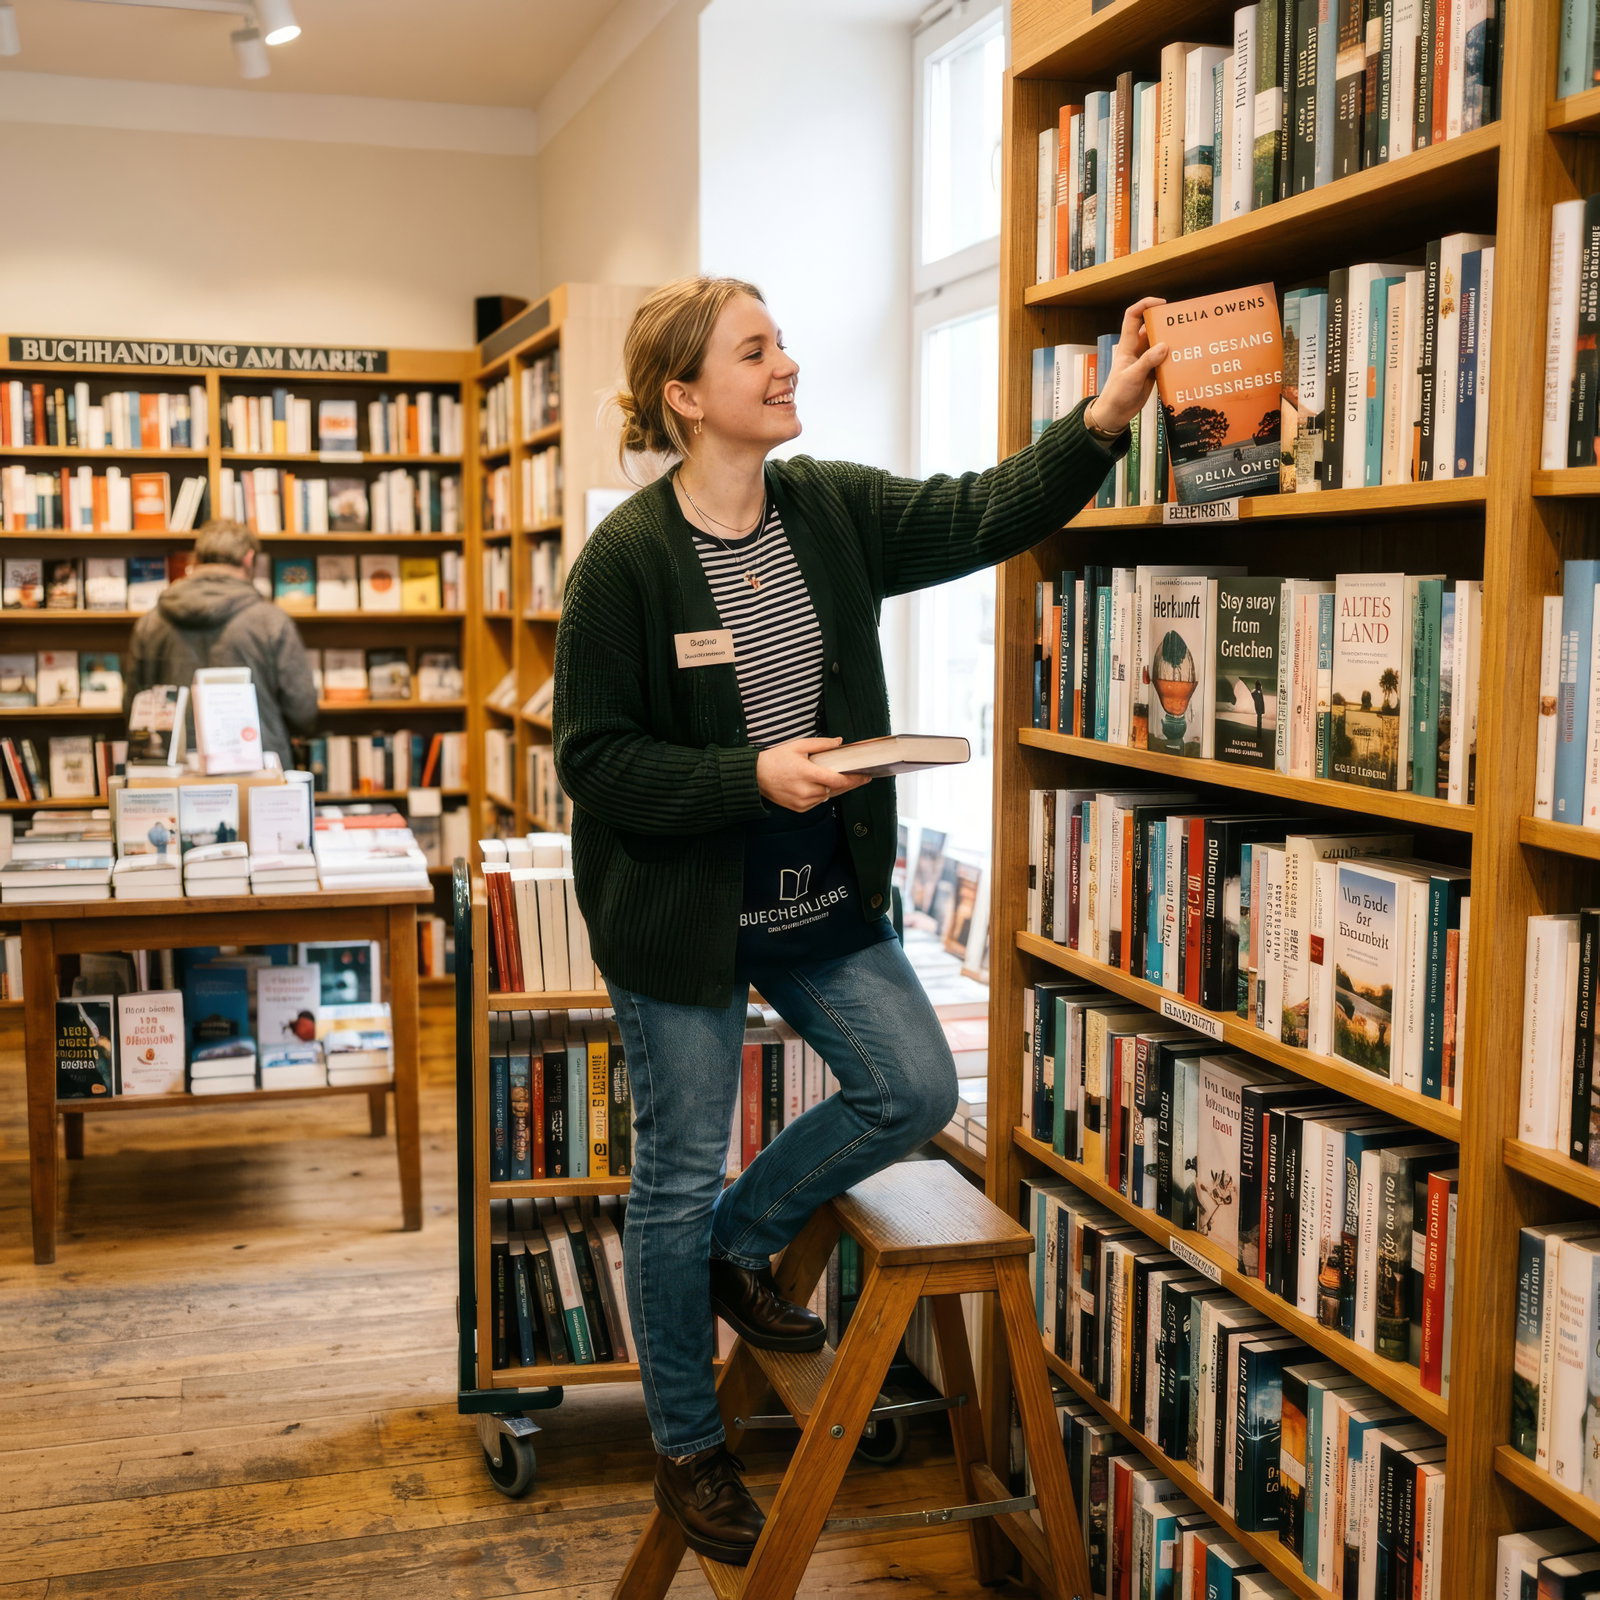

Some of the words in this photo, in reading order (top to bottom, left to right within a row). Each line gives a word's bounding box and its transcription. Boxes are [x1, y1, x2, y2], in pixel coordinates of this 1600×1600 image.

[1166, 310, 1208, 326] DELIA
[1214, 297, 1265, 316] OWENS
[21, 339, 238, 369] BUCHHANDLUNG
[242, 347, 283, 370] AM
[289, 349, 378, 373] MARKT
[1171, 346, 1202, 362] DER
[1209, 331, 1273, 355] GESANG
[1153, 594, 1200, 618] Herkunft
[1341, 596, 1391, 618] ALTES
[1232, 616, 1260, 634] from
[1341, 622, 1389, 644] LAND
[1221, 640, 1273, 659] Gretchen
